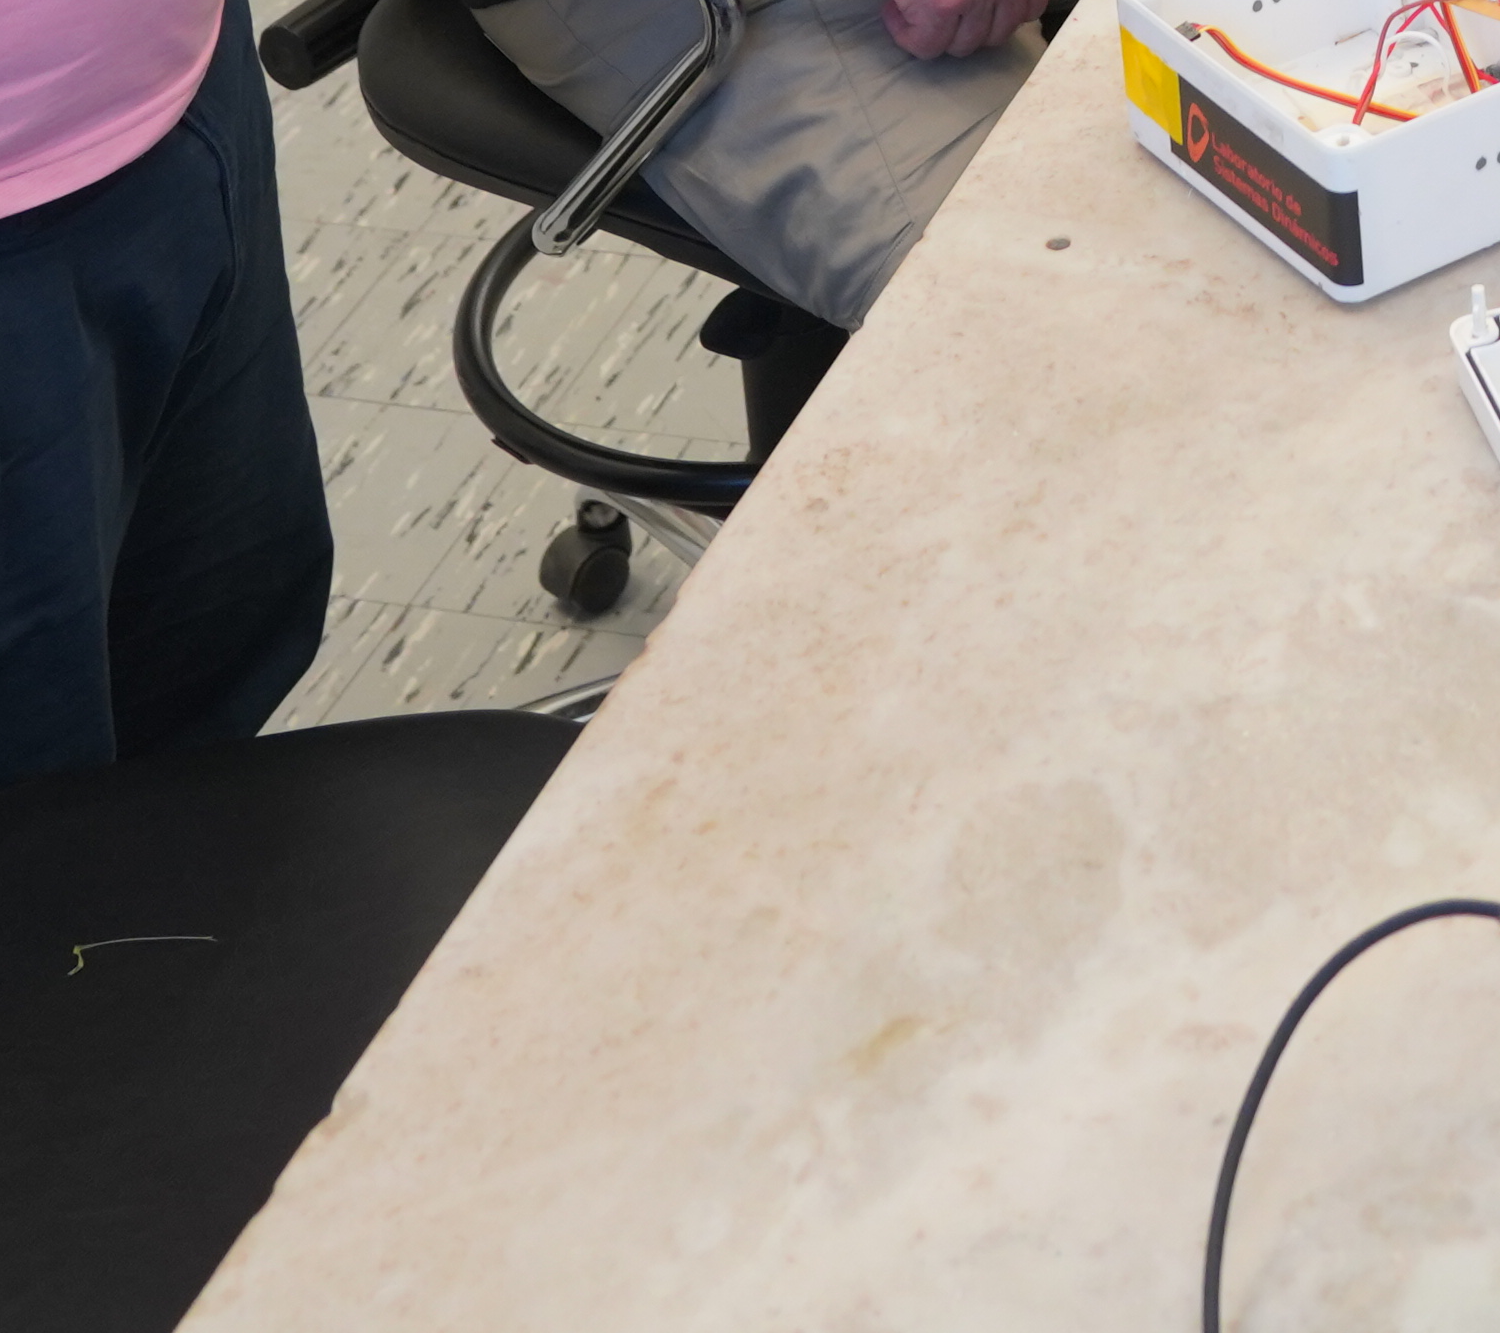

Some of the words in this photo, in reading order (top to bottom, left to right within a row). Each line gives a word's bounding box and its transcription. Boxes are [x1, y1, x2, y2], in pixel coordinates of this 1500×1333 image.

[1210, 131, 1284, 203] Laboratorio
[1285, 194, 1302, 217] de
[1212, 154, 1270, 214] Sistemas
[1271, 201, 1340, 267] Dinámicos
